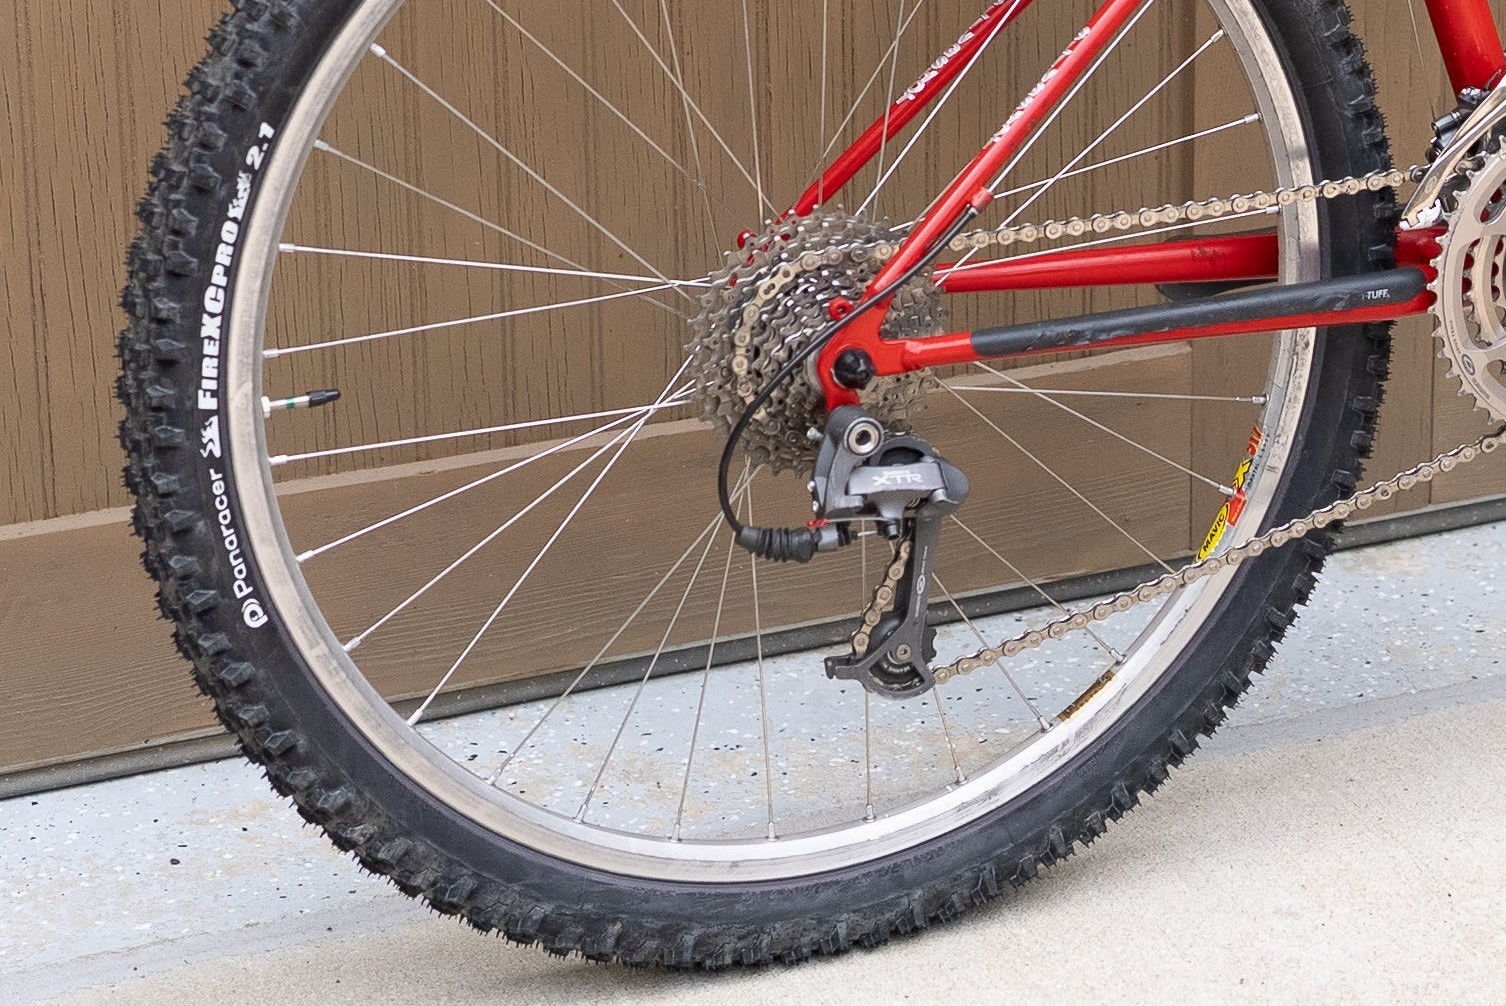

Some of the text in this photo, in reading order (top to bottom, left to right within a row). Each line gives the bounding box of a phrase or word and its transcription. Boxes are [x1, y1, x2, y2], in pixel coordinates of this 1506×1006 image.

[211, 468, 255, 601] Panaracer
[244, 121, 276, 172] 2.1
[872, 469, 923, 486] XTR
[1202, 513, 1226, 553] MAVIC
